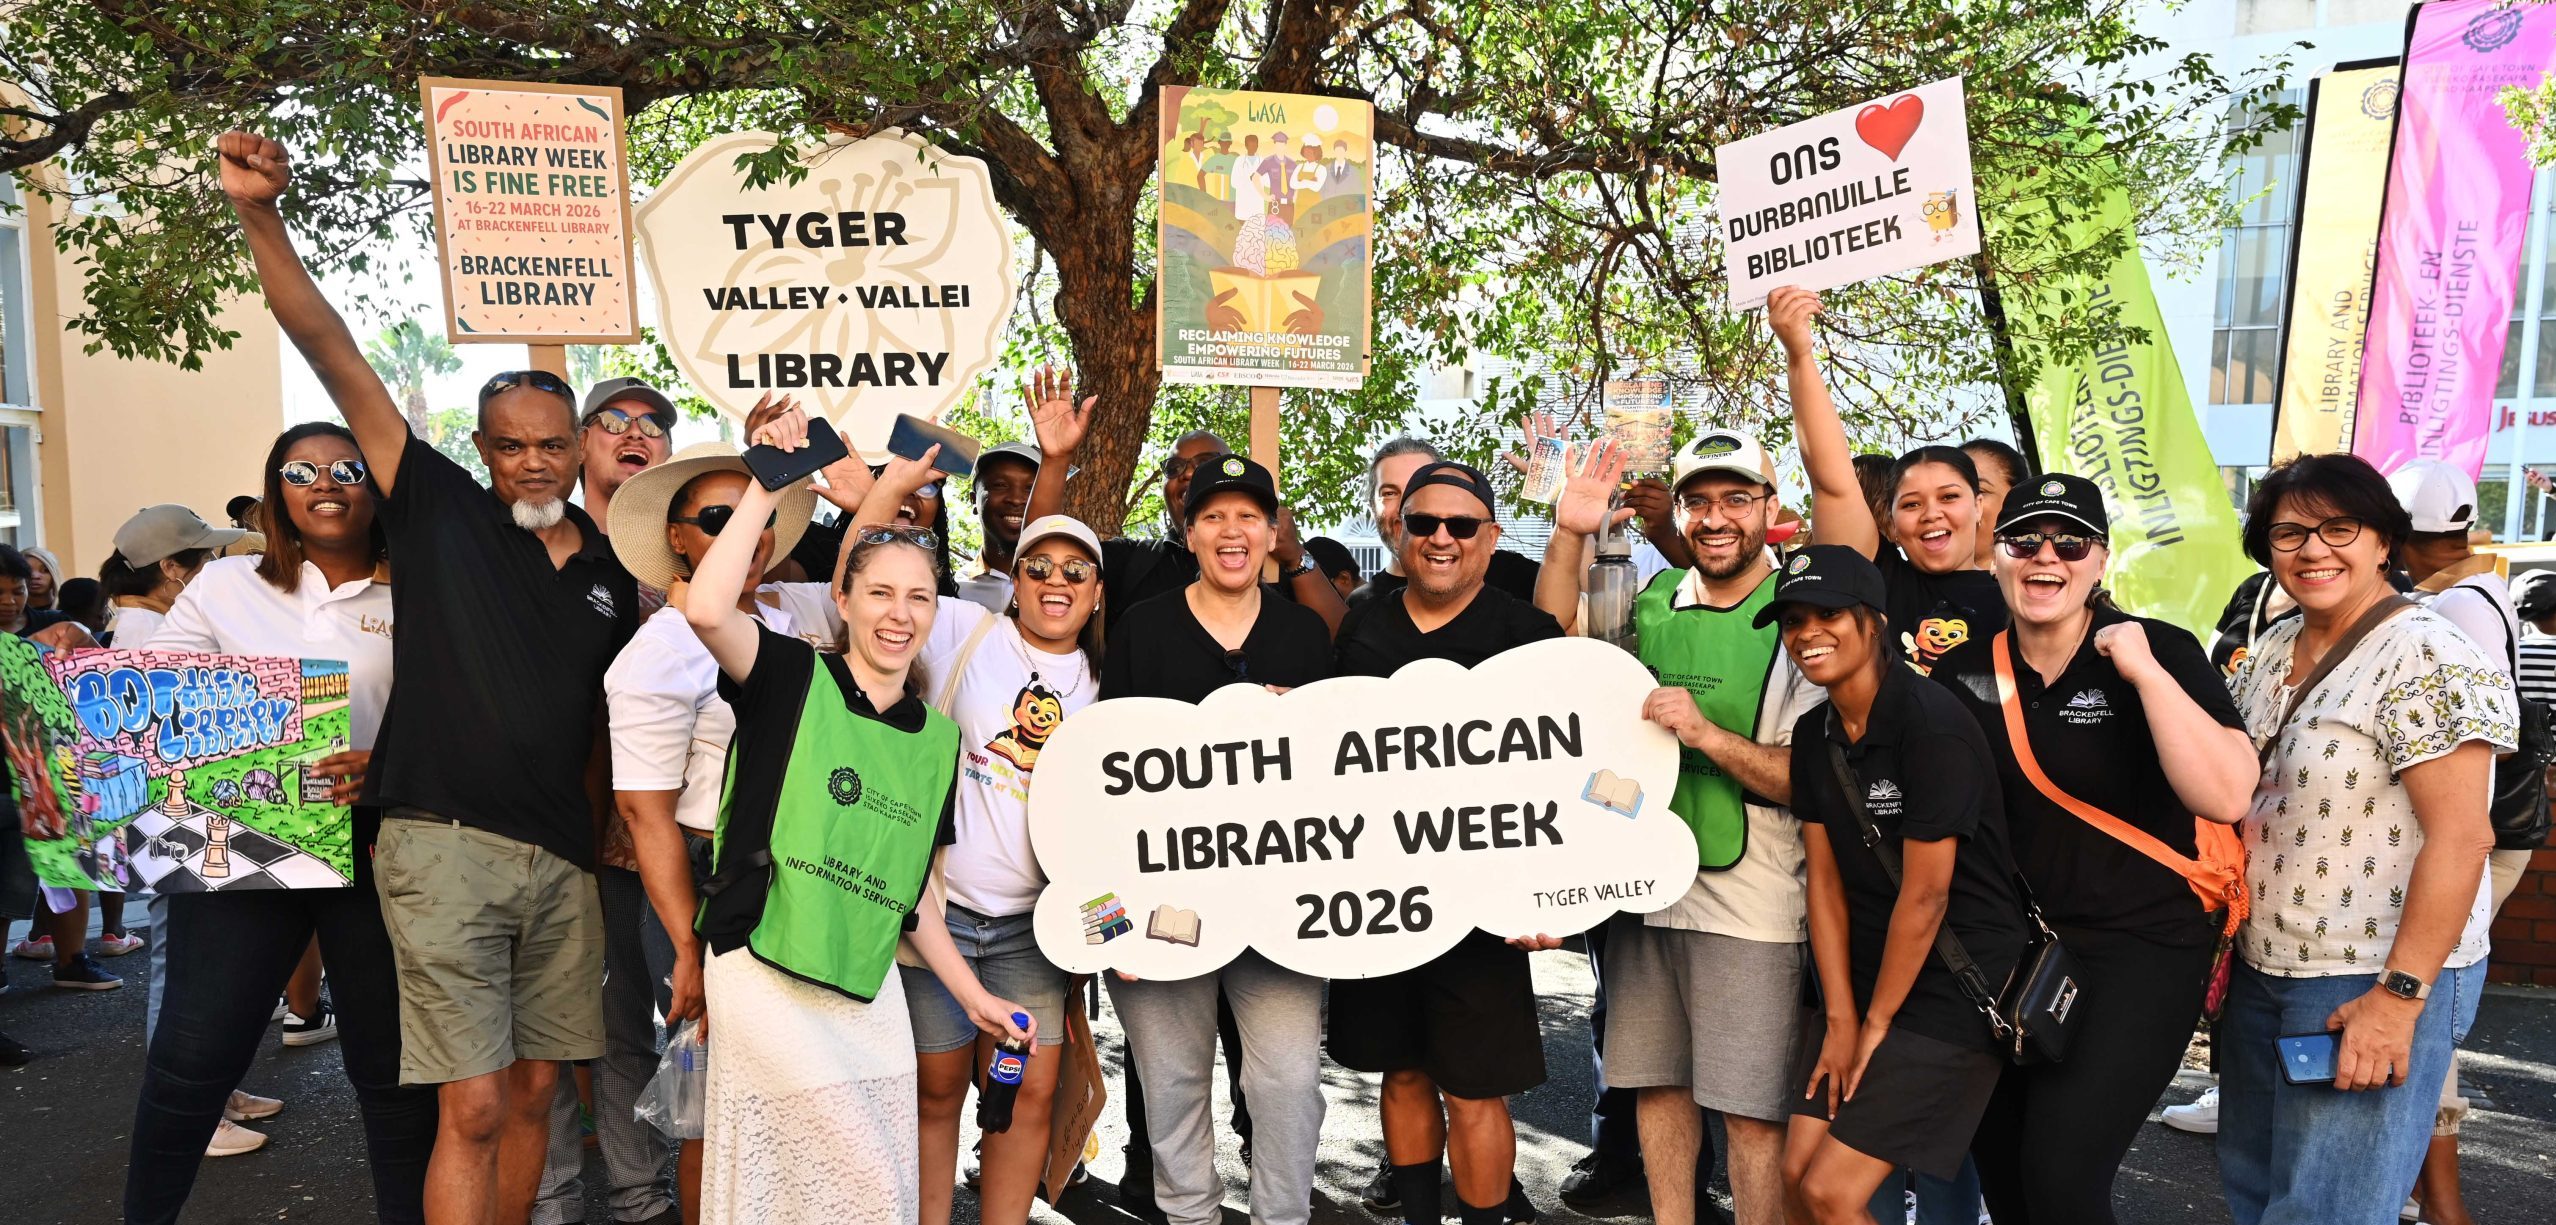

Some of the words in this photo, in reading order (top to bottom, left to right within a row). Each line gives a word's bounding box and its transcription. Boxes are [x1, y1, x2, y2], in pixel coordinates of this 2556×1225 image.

[453, 120, 516, 139] SOUTH
[521, 123, 598, 144] AFRICAN
[448, 144, 538, 168] LIBRARY
[545, 148, 608, 170] WEEK
[454, 170, 477, 194] IS
[485, 172, 538, 196] FINE
[549, 174, 608, 198] FREE
[466, 201, 506, 215] 16-22
[510, 202, 562, 217] MARCH
[566, 204, 601, 218] 2026
[1729, 167, 1912, 243] DURBANVILLE
[458, 219, 472, 230] AT
[476, 220, 558, 233] BRACKENFELL
[561, 222, 610, 234] LIBRARY
[722, 211, 909, 250] TYGER
[1747, 214, 1902, 280] BIBLIOTEEK
[460, 255, 612, 278] BRACKENFELL
[2420, 250, 2442, 281] EN
[480, 281, 596, 306] LIBRARY
[702, 286, 830, 310] VALLEY
[856, 284, 970, 308] VALLEI
[2330, 289, 2353, 331] AND
[1178, 329, 1264, 344] RECLAIMING
[1266, 332, 1350, 348] KNOWLEDGE
[2420, 220, 2478, 456] INLIGTINGS-DIENSTE
[1174, 355, 1196, 364] SOUTH
[1198, 356, 1228, 366] AFRICAN
[1230, 357, 1260, 367] LIBRARY
[1261, 358, 1280, 368] WEEK
[1288, 360, 1308, 369] 16-22
[1310, 360, 1335, 370] MARCH
[1337, 362, 1354, 371] 2026
[1188, 343, 1281, 358] EMPOWERING
[1284, 346, 1342, 360] FUTURES
[726, 351, 950, 388] LIBRARY
[2320, 336, 2346, 413] LIBRARY
[2061, 500, 2078, 509] TOWN
[1684, 682, 1716, 690] SASEKAPA
[1703, 676, 1724, 684] TOWN
[2059, 710, 2114, 718] BRACKENFELL
[1102, 736, 1292, 797] SOUTH
[1334, 712, 1583, 776] AFRICAN
[1680, 750, 1694, 760] ND
[964, 768, 992, 786] TARTS
[994, 782, 1007, 792] AT
[1680, 762, 1722, 777] ERVICES
[866, 787, 880, 798] CITY
[890, 799, 908, 810] CAPE
[863, 802, 879, 813] STAD
[880, 810, 911, 827] KAAPSTAD
[890, 807, 918, 824] SASEKAPA
[1136, 813, 1366, 874] LIBRARY
[1394, 801, 1564, 856] WEEK
[785, 856, 862, 895] INFORMATION
[824, 855, 863, 880] LIBRARY
[864, 874, 887, 890] AND
[1533, 888, 1590, 910] TYGER
[1594, 879, 1656, 902] VALLEY
[1295, 886, 1434, 941] 2026
[1000, 1064, 1020, 1072] PEPSI
